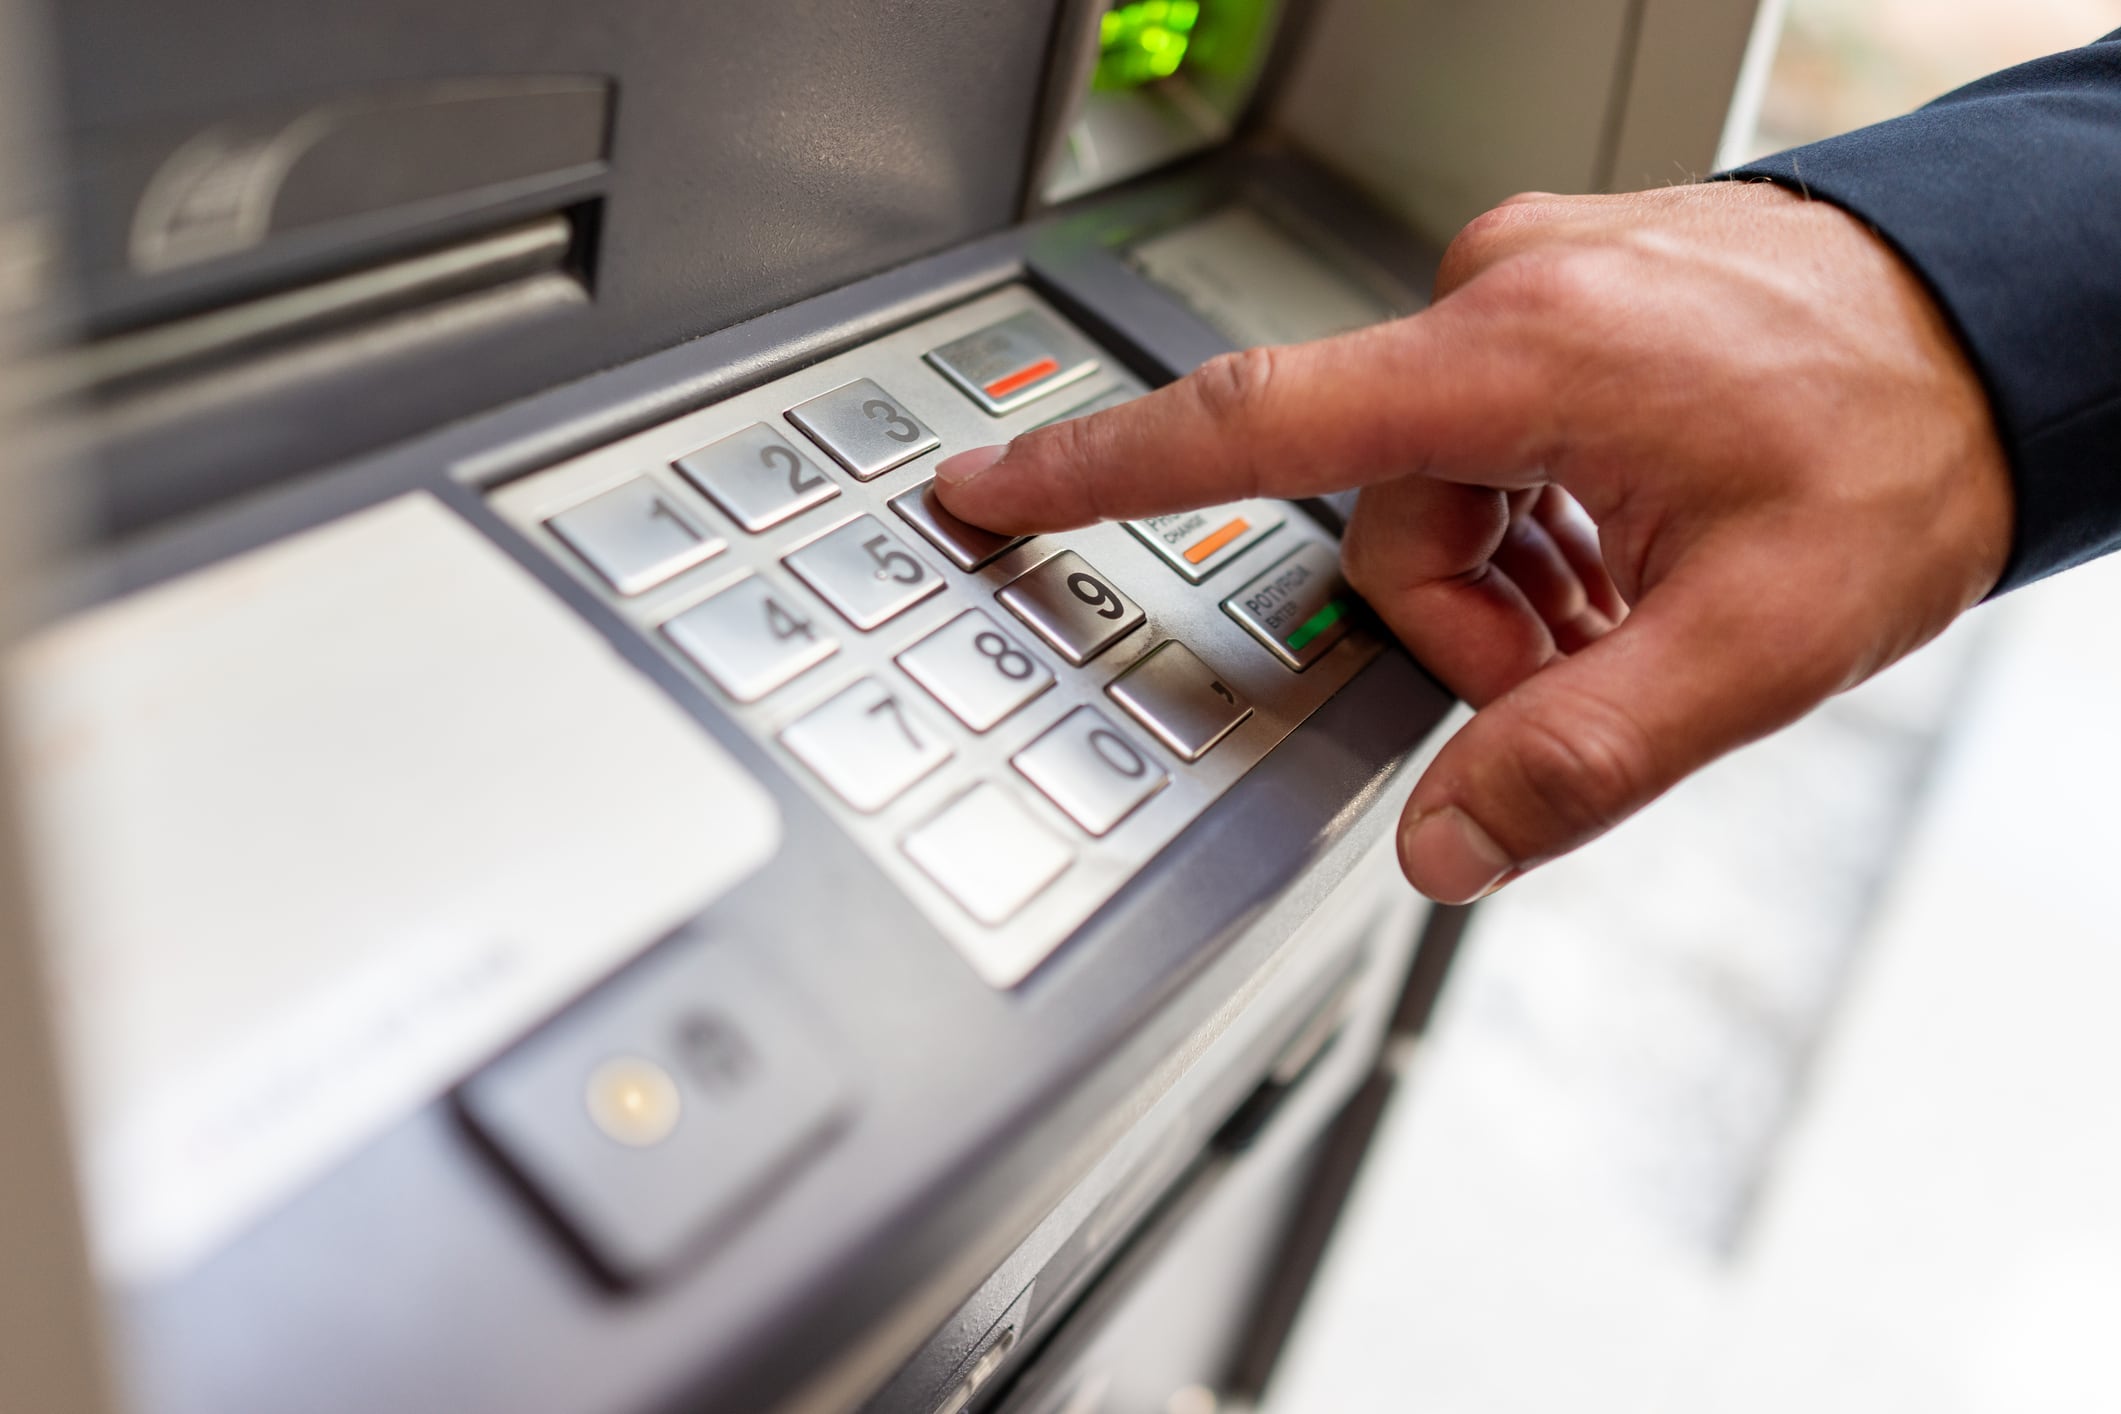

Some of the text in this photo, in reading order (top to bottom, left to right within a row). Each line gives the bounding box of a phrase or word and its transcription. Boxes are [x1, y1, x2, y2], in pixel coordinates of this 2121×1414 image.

[862, 400, 920, 443] 3
[760, 445, 826, 494] 2
[650, 496, 702, 542] 1
[862, 534, 924, 584] 5
[763, 597, 818, 642] 4
[1067, 572, 1124, 620] 9
[974, 631, 1034, 680] 8
[865, 694, 924, 751] 7
[1088, 729, 1146, 778] 0
